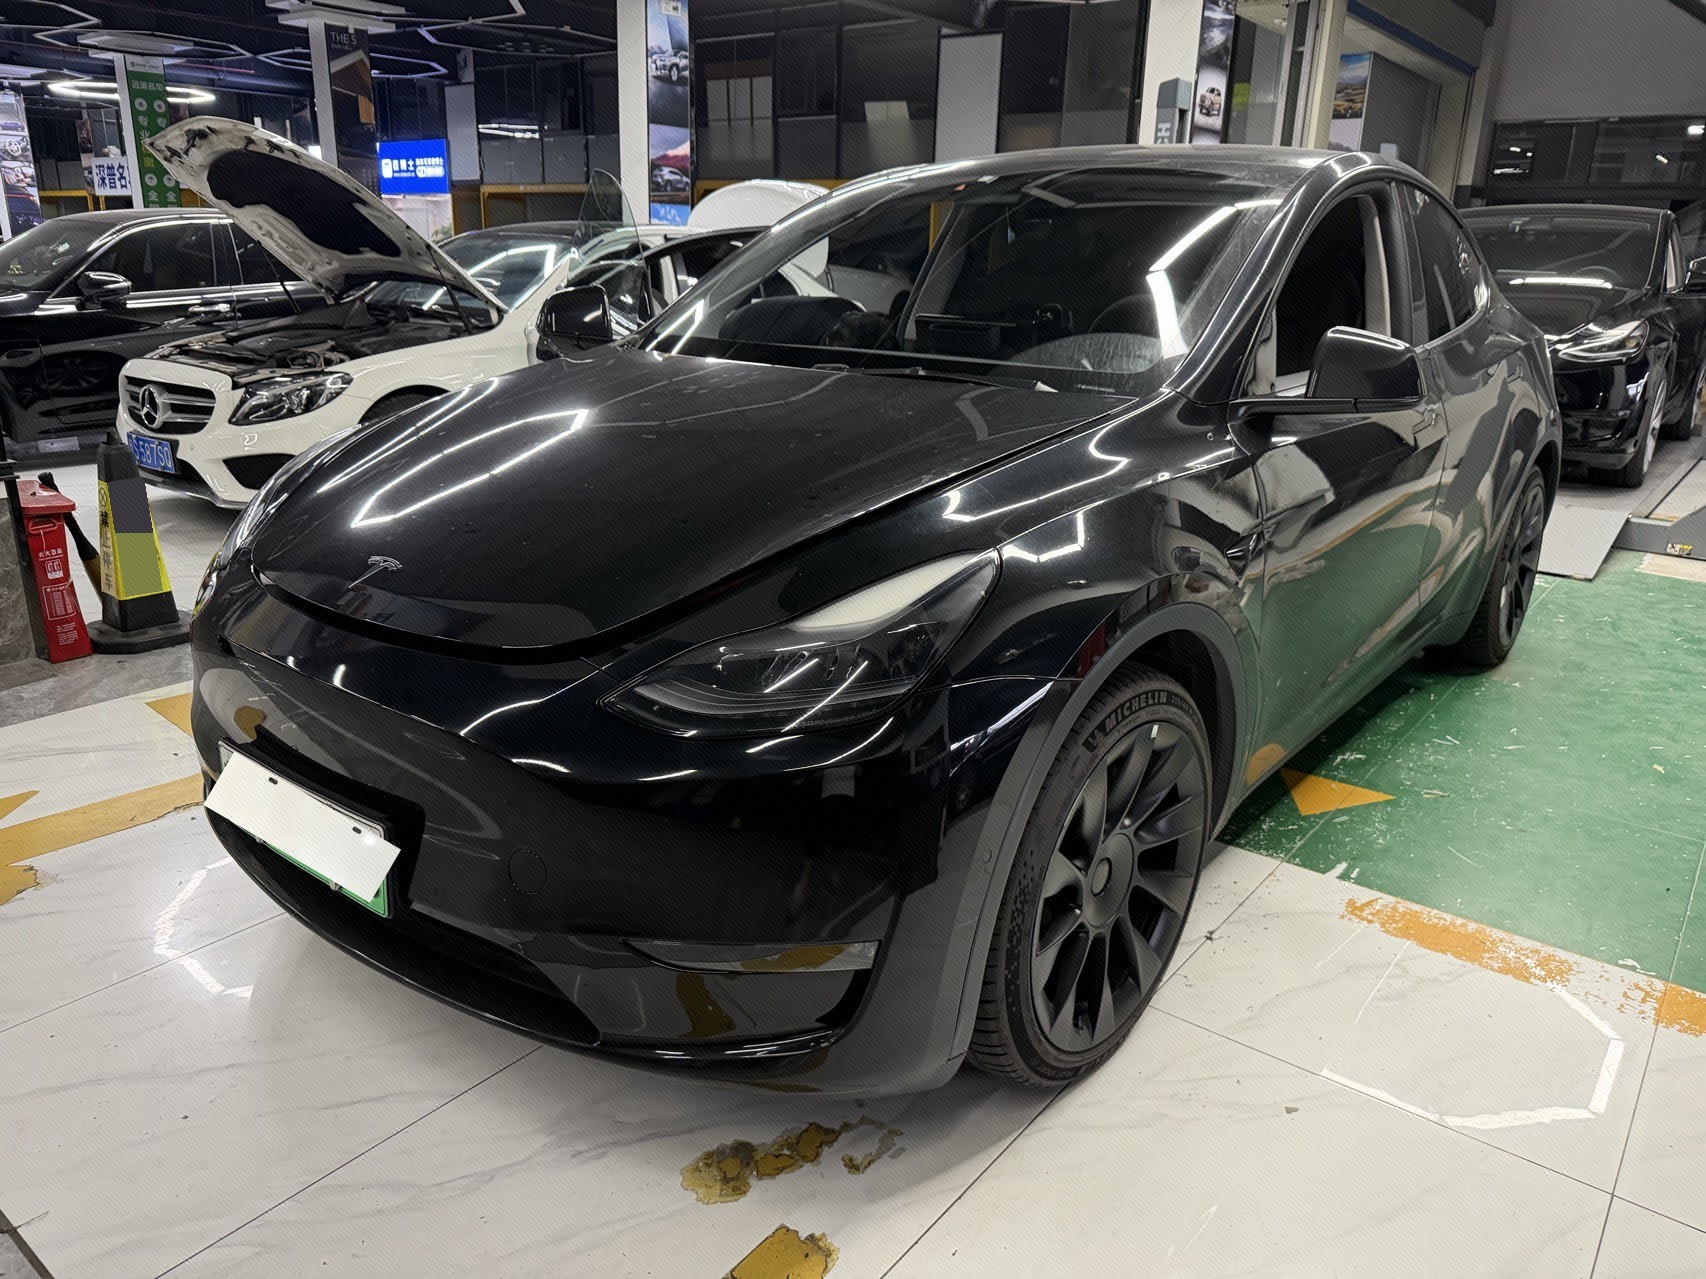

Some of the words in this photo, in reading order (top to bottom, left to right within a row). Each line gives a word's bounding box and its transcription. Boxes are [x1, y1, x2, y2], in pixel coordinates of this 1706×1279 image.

[330, 31, 349, 44] THE
[95, 162, 131, 190] 深普名
[1105, 691, 1167, 732] MICHELIN
